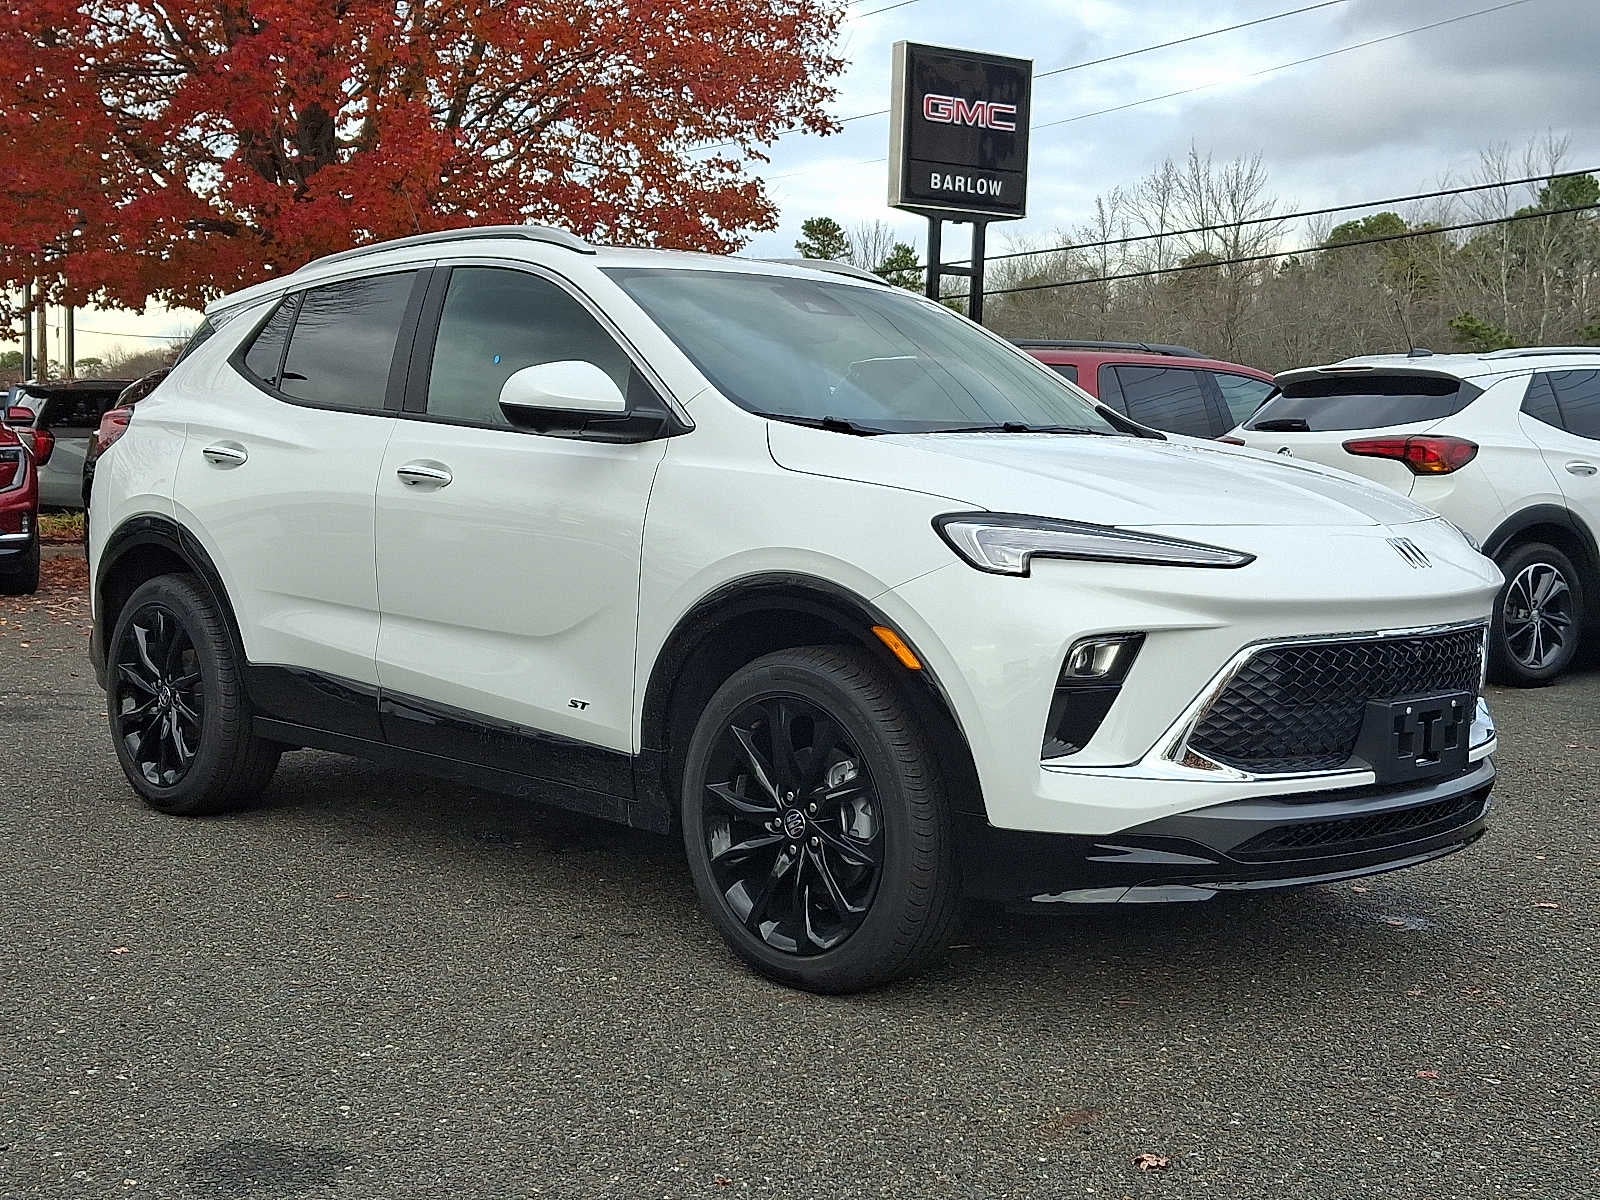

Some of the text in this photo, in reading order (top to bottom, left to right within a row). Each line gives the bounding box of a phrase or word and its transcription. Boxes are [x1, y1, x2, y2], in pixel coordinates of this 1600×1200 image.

[923, 93, 1017, 131] GMC
[930, 173, 1002, 196] BARLOW
[567, 699, 590, 711] ST
